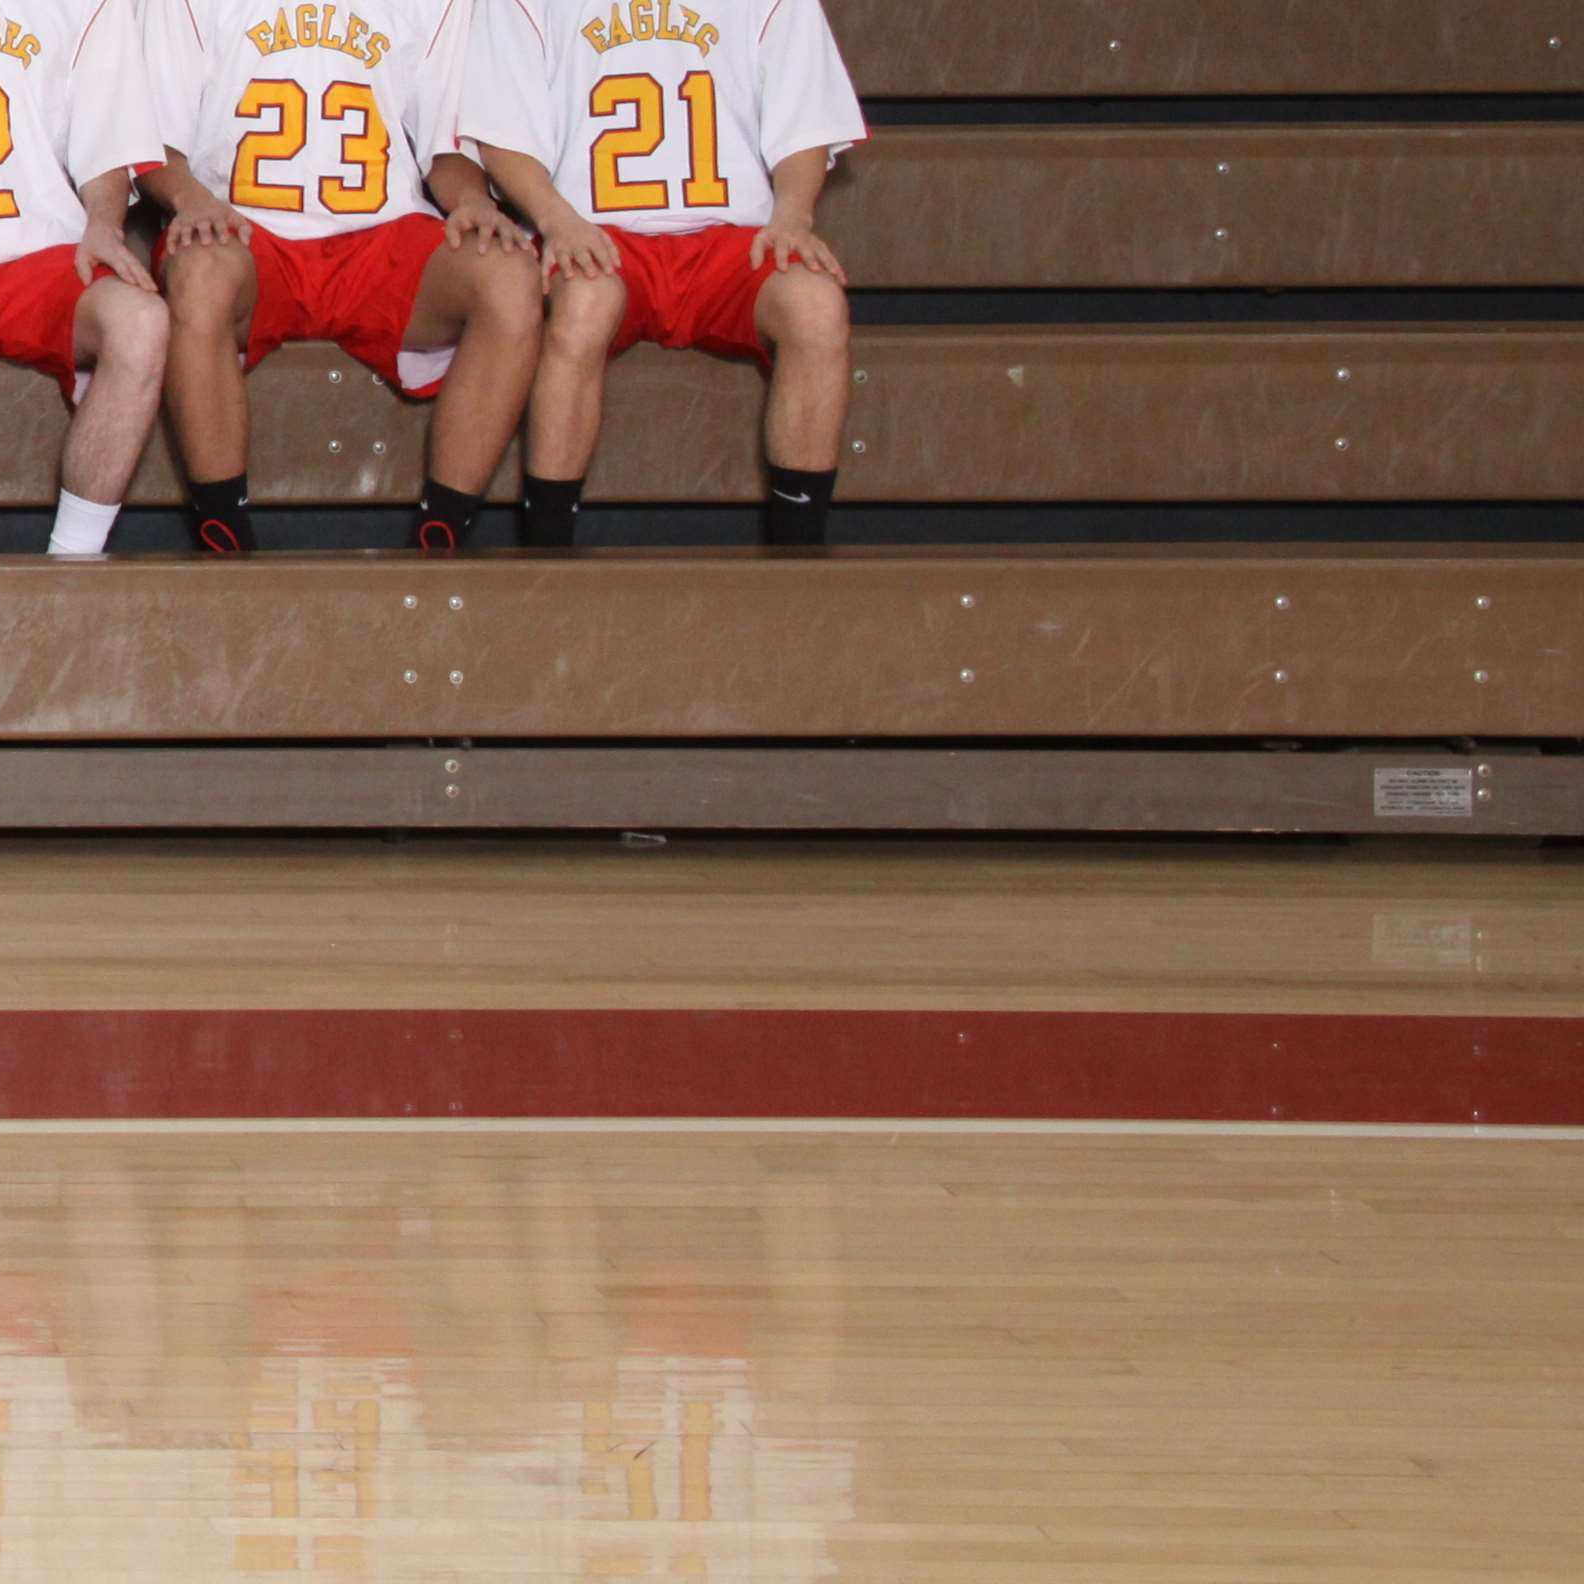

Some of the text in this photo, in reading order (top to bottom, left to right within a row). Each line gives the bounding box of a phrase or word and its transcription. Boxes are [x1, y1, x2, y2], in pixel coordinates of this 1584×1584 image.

[247, 2, 391, 69] EAGLES
[230, 78, 392, 215] 23
[589, 70, 730, 212] 21
